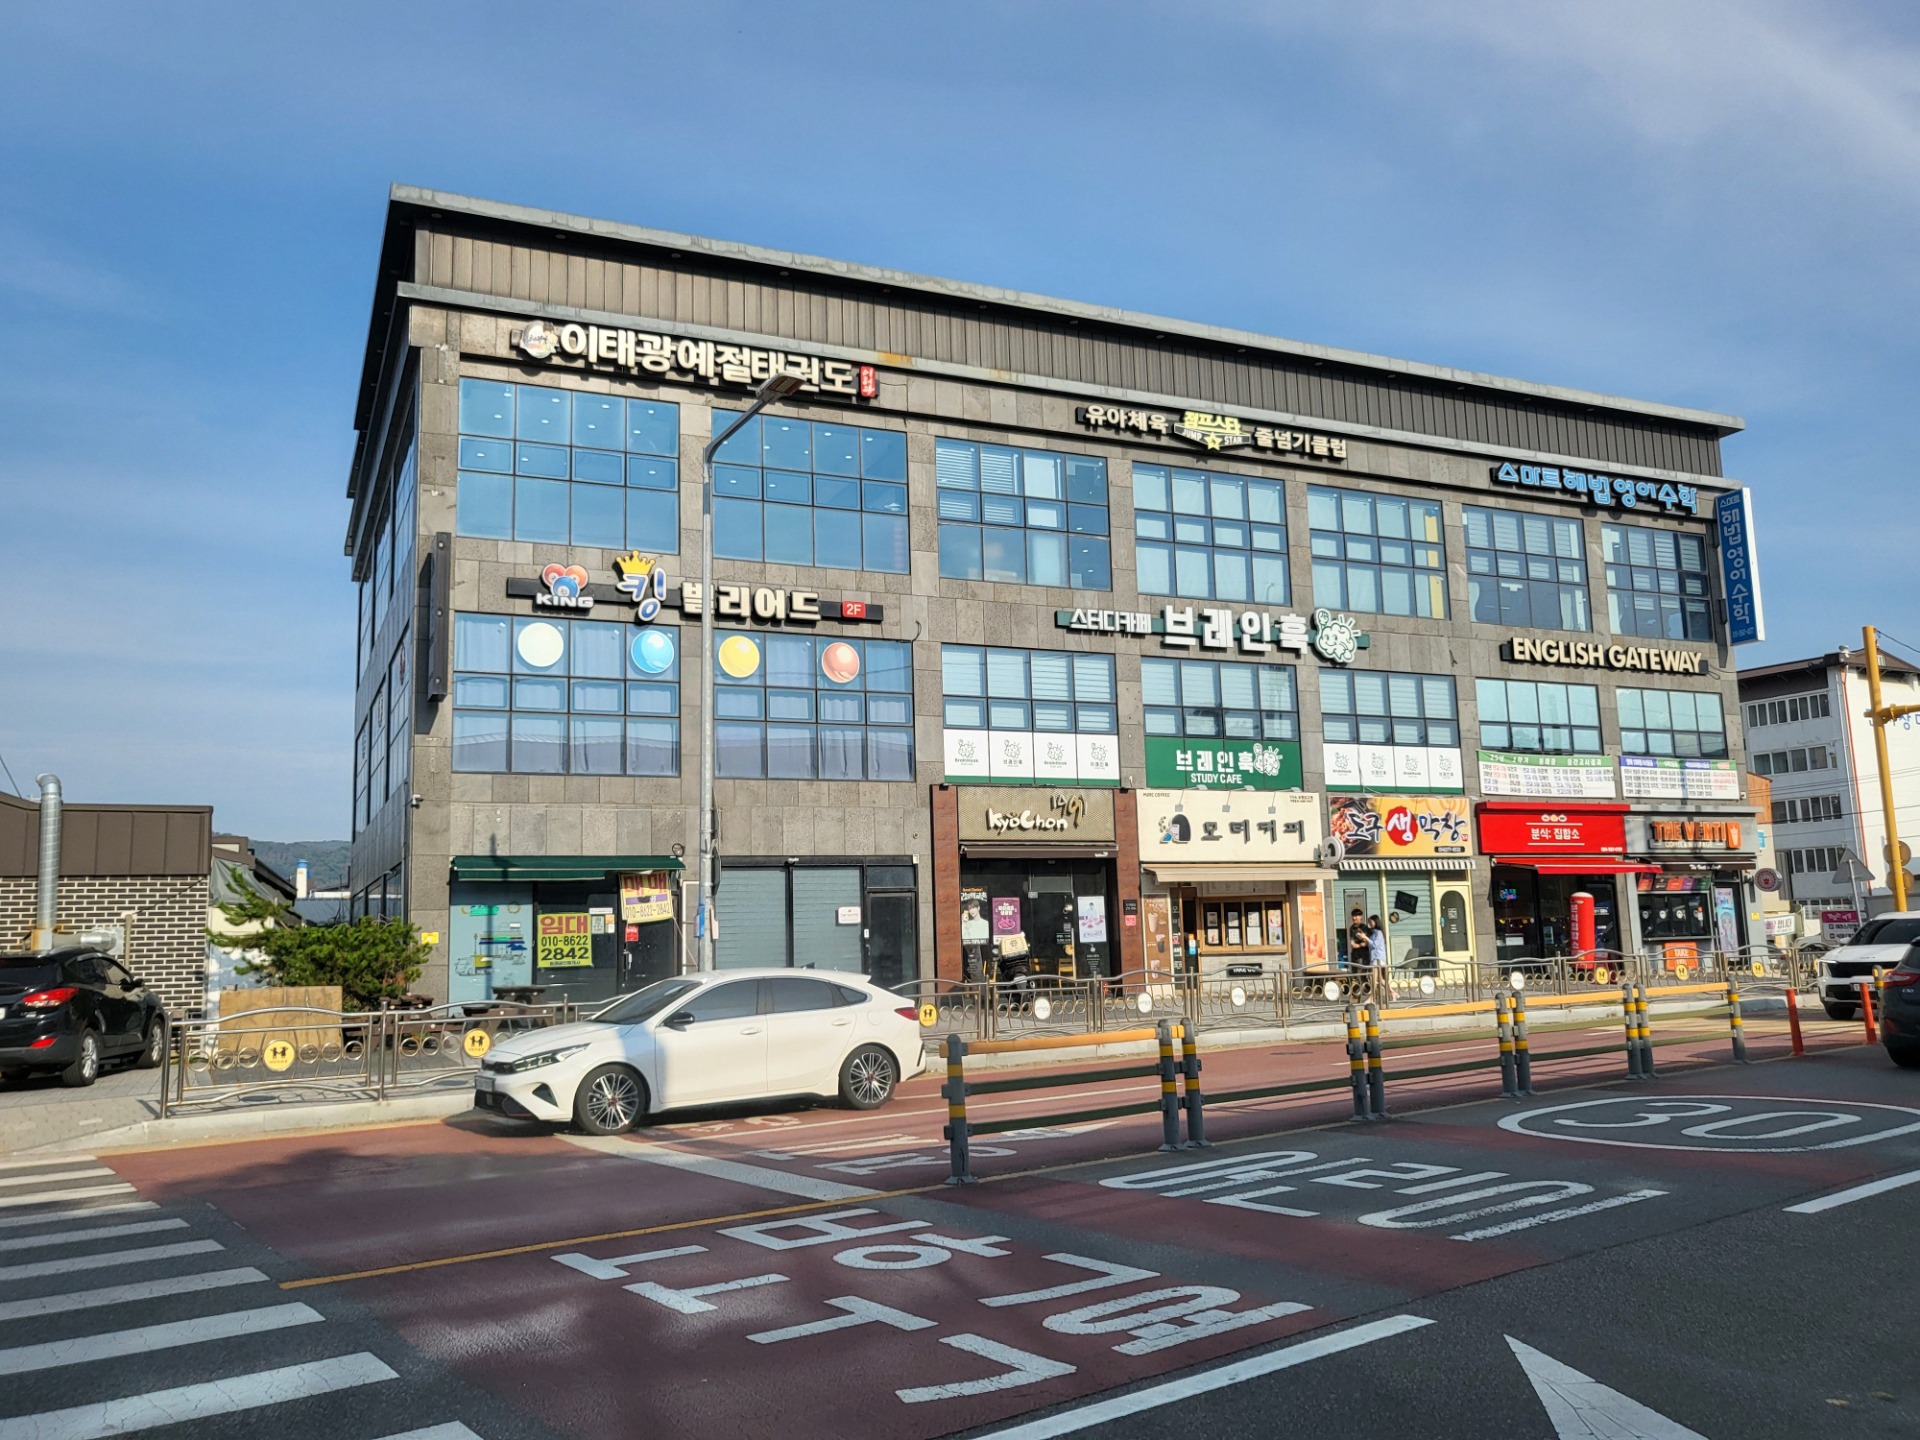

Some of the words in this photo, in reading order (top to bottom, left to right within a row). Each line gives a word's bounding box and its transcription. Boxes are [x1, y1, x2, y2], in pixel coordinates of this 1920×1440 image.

[1085, 404, 1169, 434] 유아체육
[1182, 428, 1202, 441] JUMP
[1224, 436, 1243, 446] STAR
[1254, 427, 1347, 459] 줄넘기클럽
[536, 592, 594, 608] KING
[846, 603, 863, 616] 2F
[1069, 607, 1151, 633] 스터디카페
[1164, 605, 1308, 655] 브레인훅
[1512, 636, 1604, 666] ENGLISH
[1608, 644, 1702, 673] GATEWAY
[1176, 749, 1254, 774] 브레인훅
[1190, 773, 1219, 784] STUDY
[1219, 774, 1242, 784] CAFE
[1652, 821, 1682, 841] THE
[1684, 821, 1727, 842] VENTI
[625, 902, 670, 919] 010-8622-2842
[540, 915, 588, 935] 임대
[541, 935, 588, 947] 010-8622
[540, 947, 589, 961] 2842
[1098, 1150, 1671, 1242] 어린이
